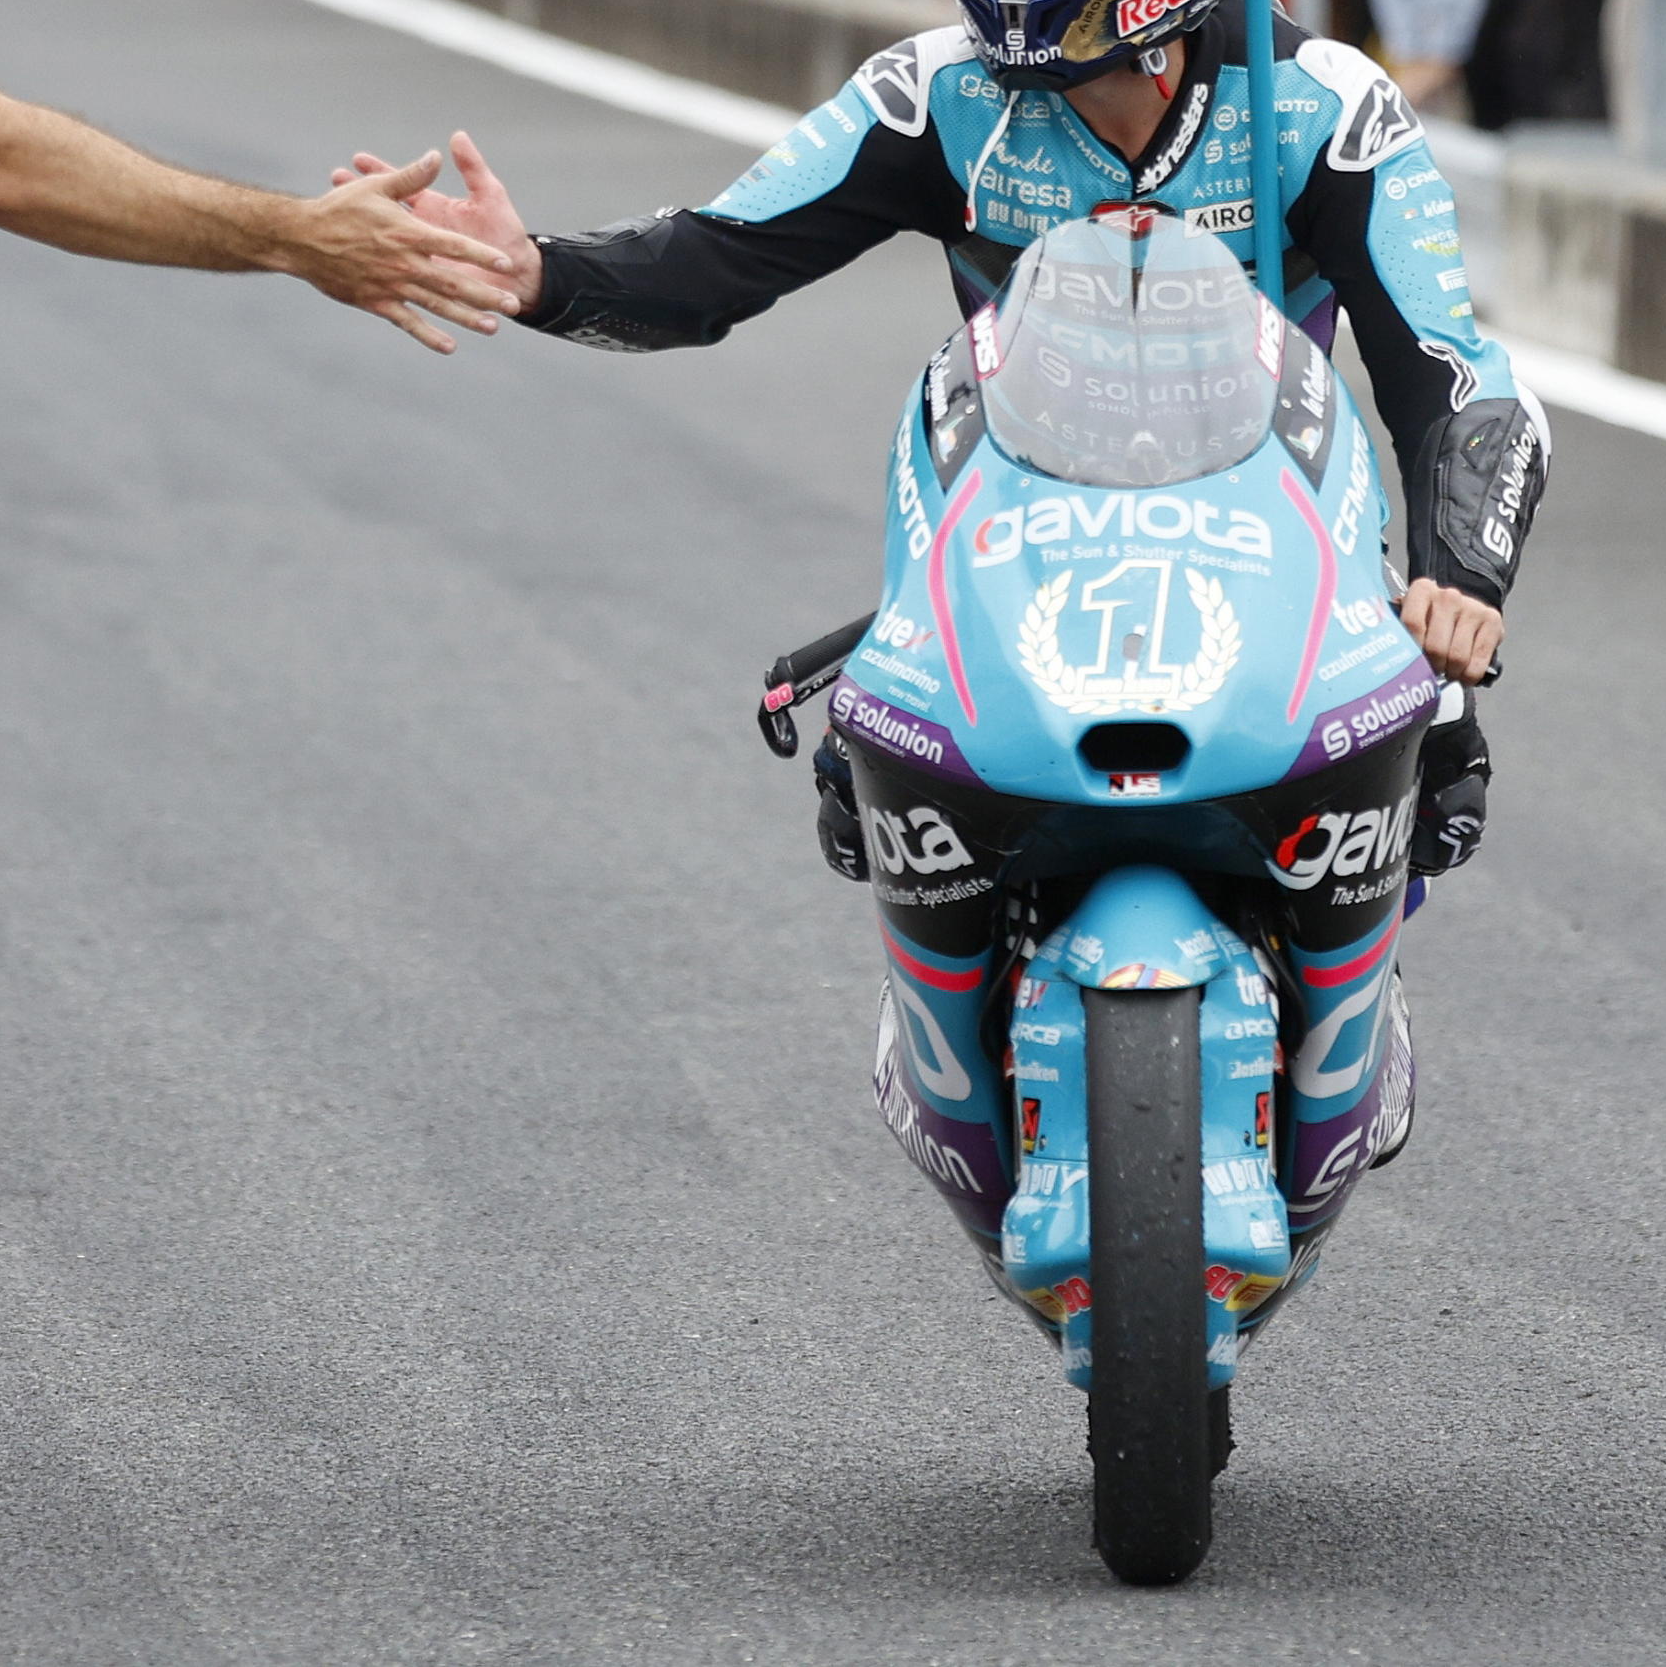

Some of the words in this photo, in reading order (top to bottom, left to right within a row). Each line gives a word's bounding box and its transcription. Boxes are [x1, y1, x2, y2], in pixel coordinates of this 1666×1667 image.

[1194, 203, 1255, 231] AIRO
[1085, 368, 1261, 408] solunion
[1497, 420, 1540, 525] solunion
[971, 493, 1273, 569] gaviota
[1040, 549, 1072, 564] The
[1072, 545, 1104, 560] Sun
[1107, 544, 1119, 559] &
[1122, 544, 1184, 561] Shutter
[1188, 549, 1273, 576] Specialists
[860, 647, 941, 695] azulmarino
[1350, 678, 1436, 738] solunion
[853, 698, 944, 766] solunion
[918, 877, 994, 909] Specialists
[1331, 886, 1355, 906] The
